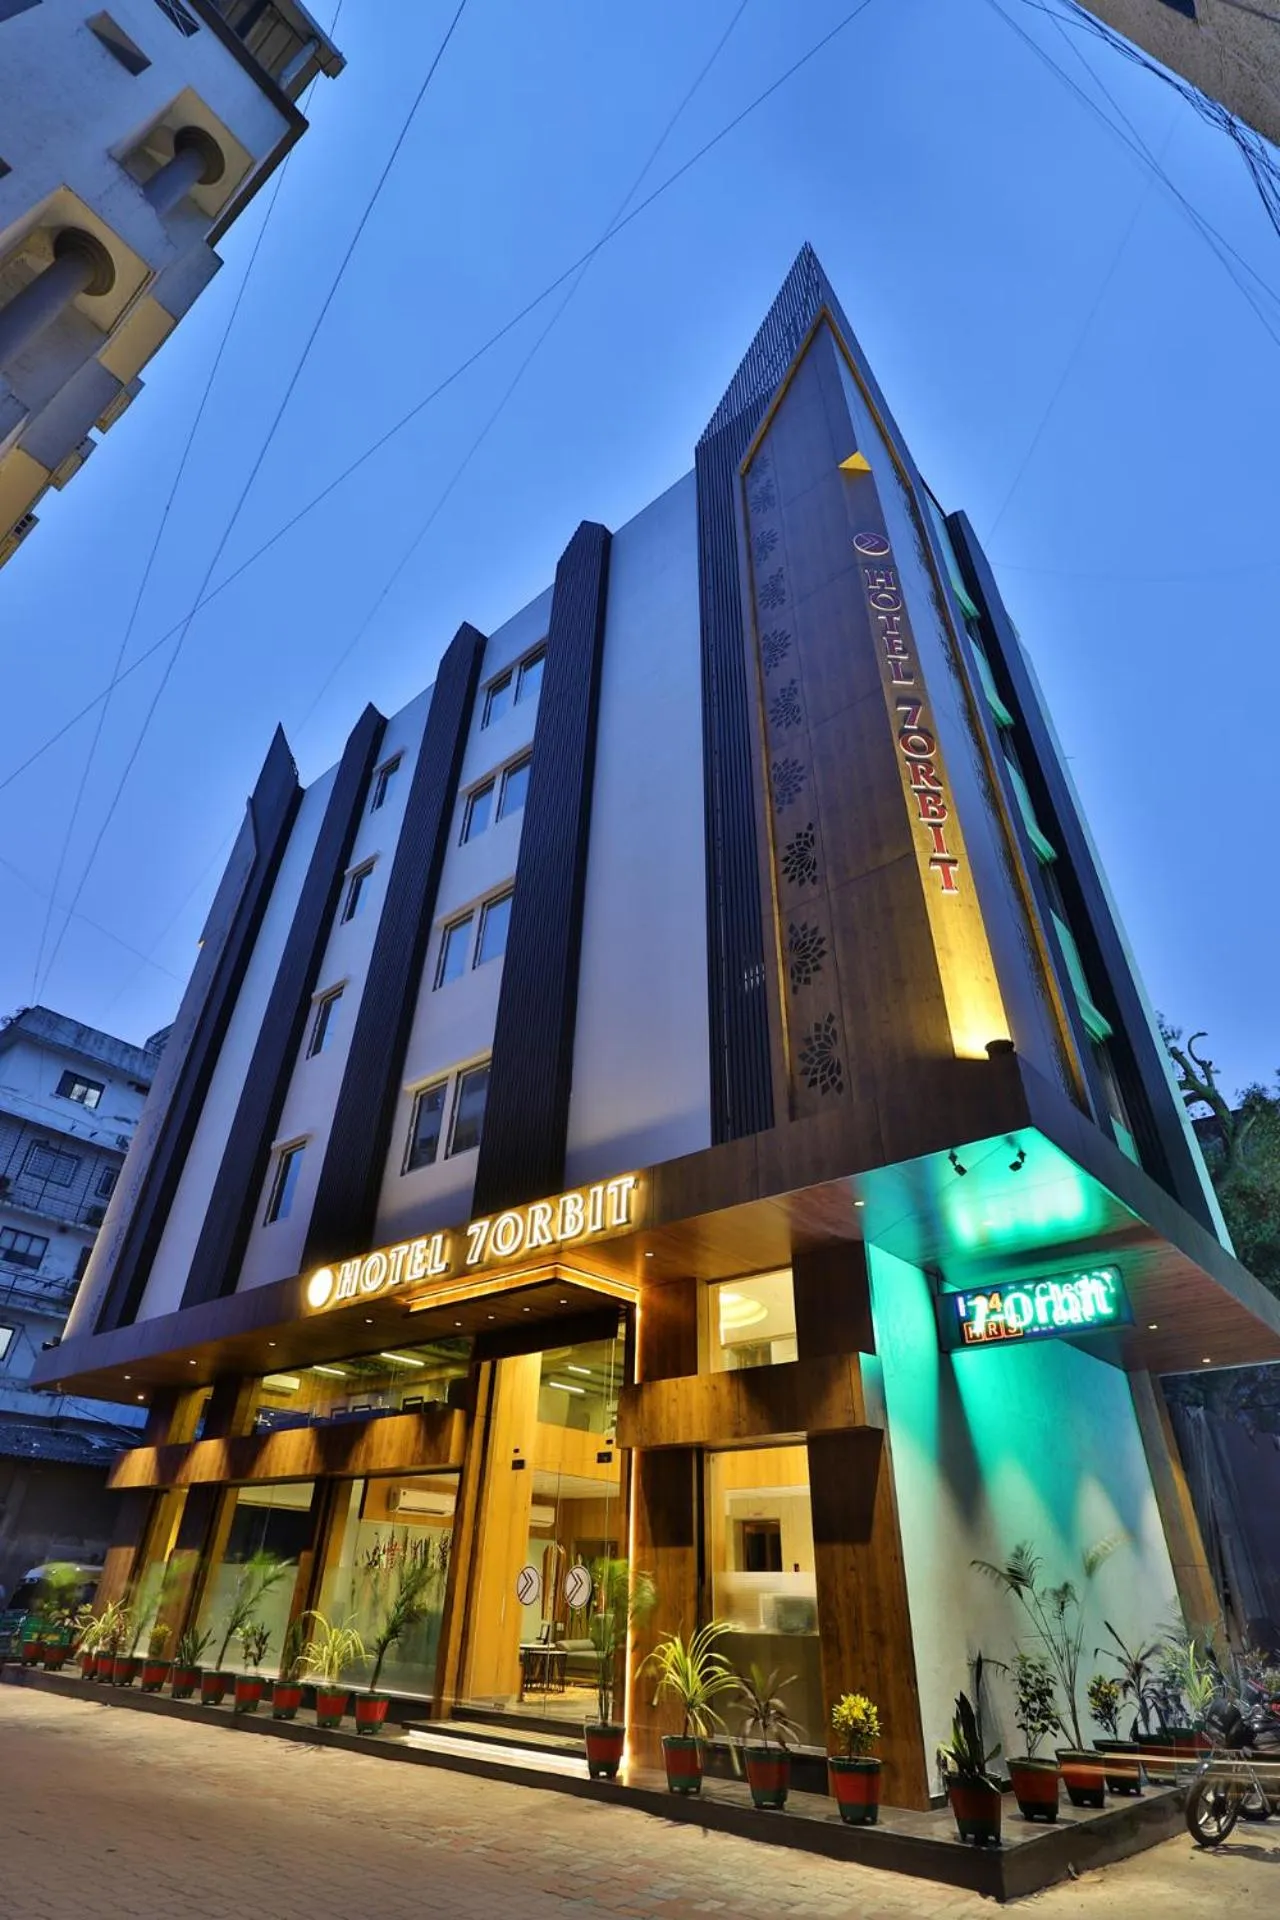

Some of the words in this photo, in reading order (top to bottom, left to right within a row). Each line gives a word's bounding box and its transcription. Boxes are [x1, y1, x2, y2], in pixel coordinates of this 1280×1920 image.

[866, 568, 914, 684] HOTEL
[897, 705, 959, 894] 7ORBIT
[337, 1233, 448, 1299] HOTEL
[466, 1175, 637, 1265] 7ORBIT
